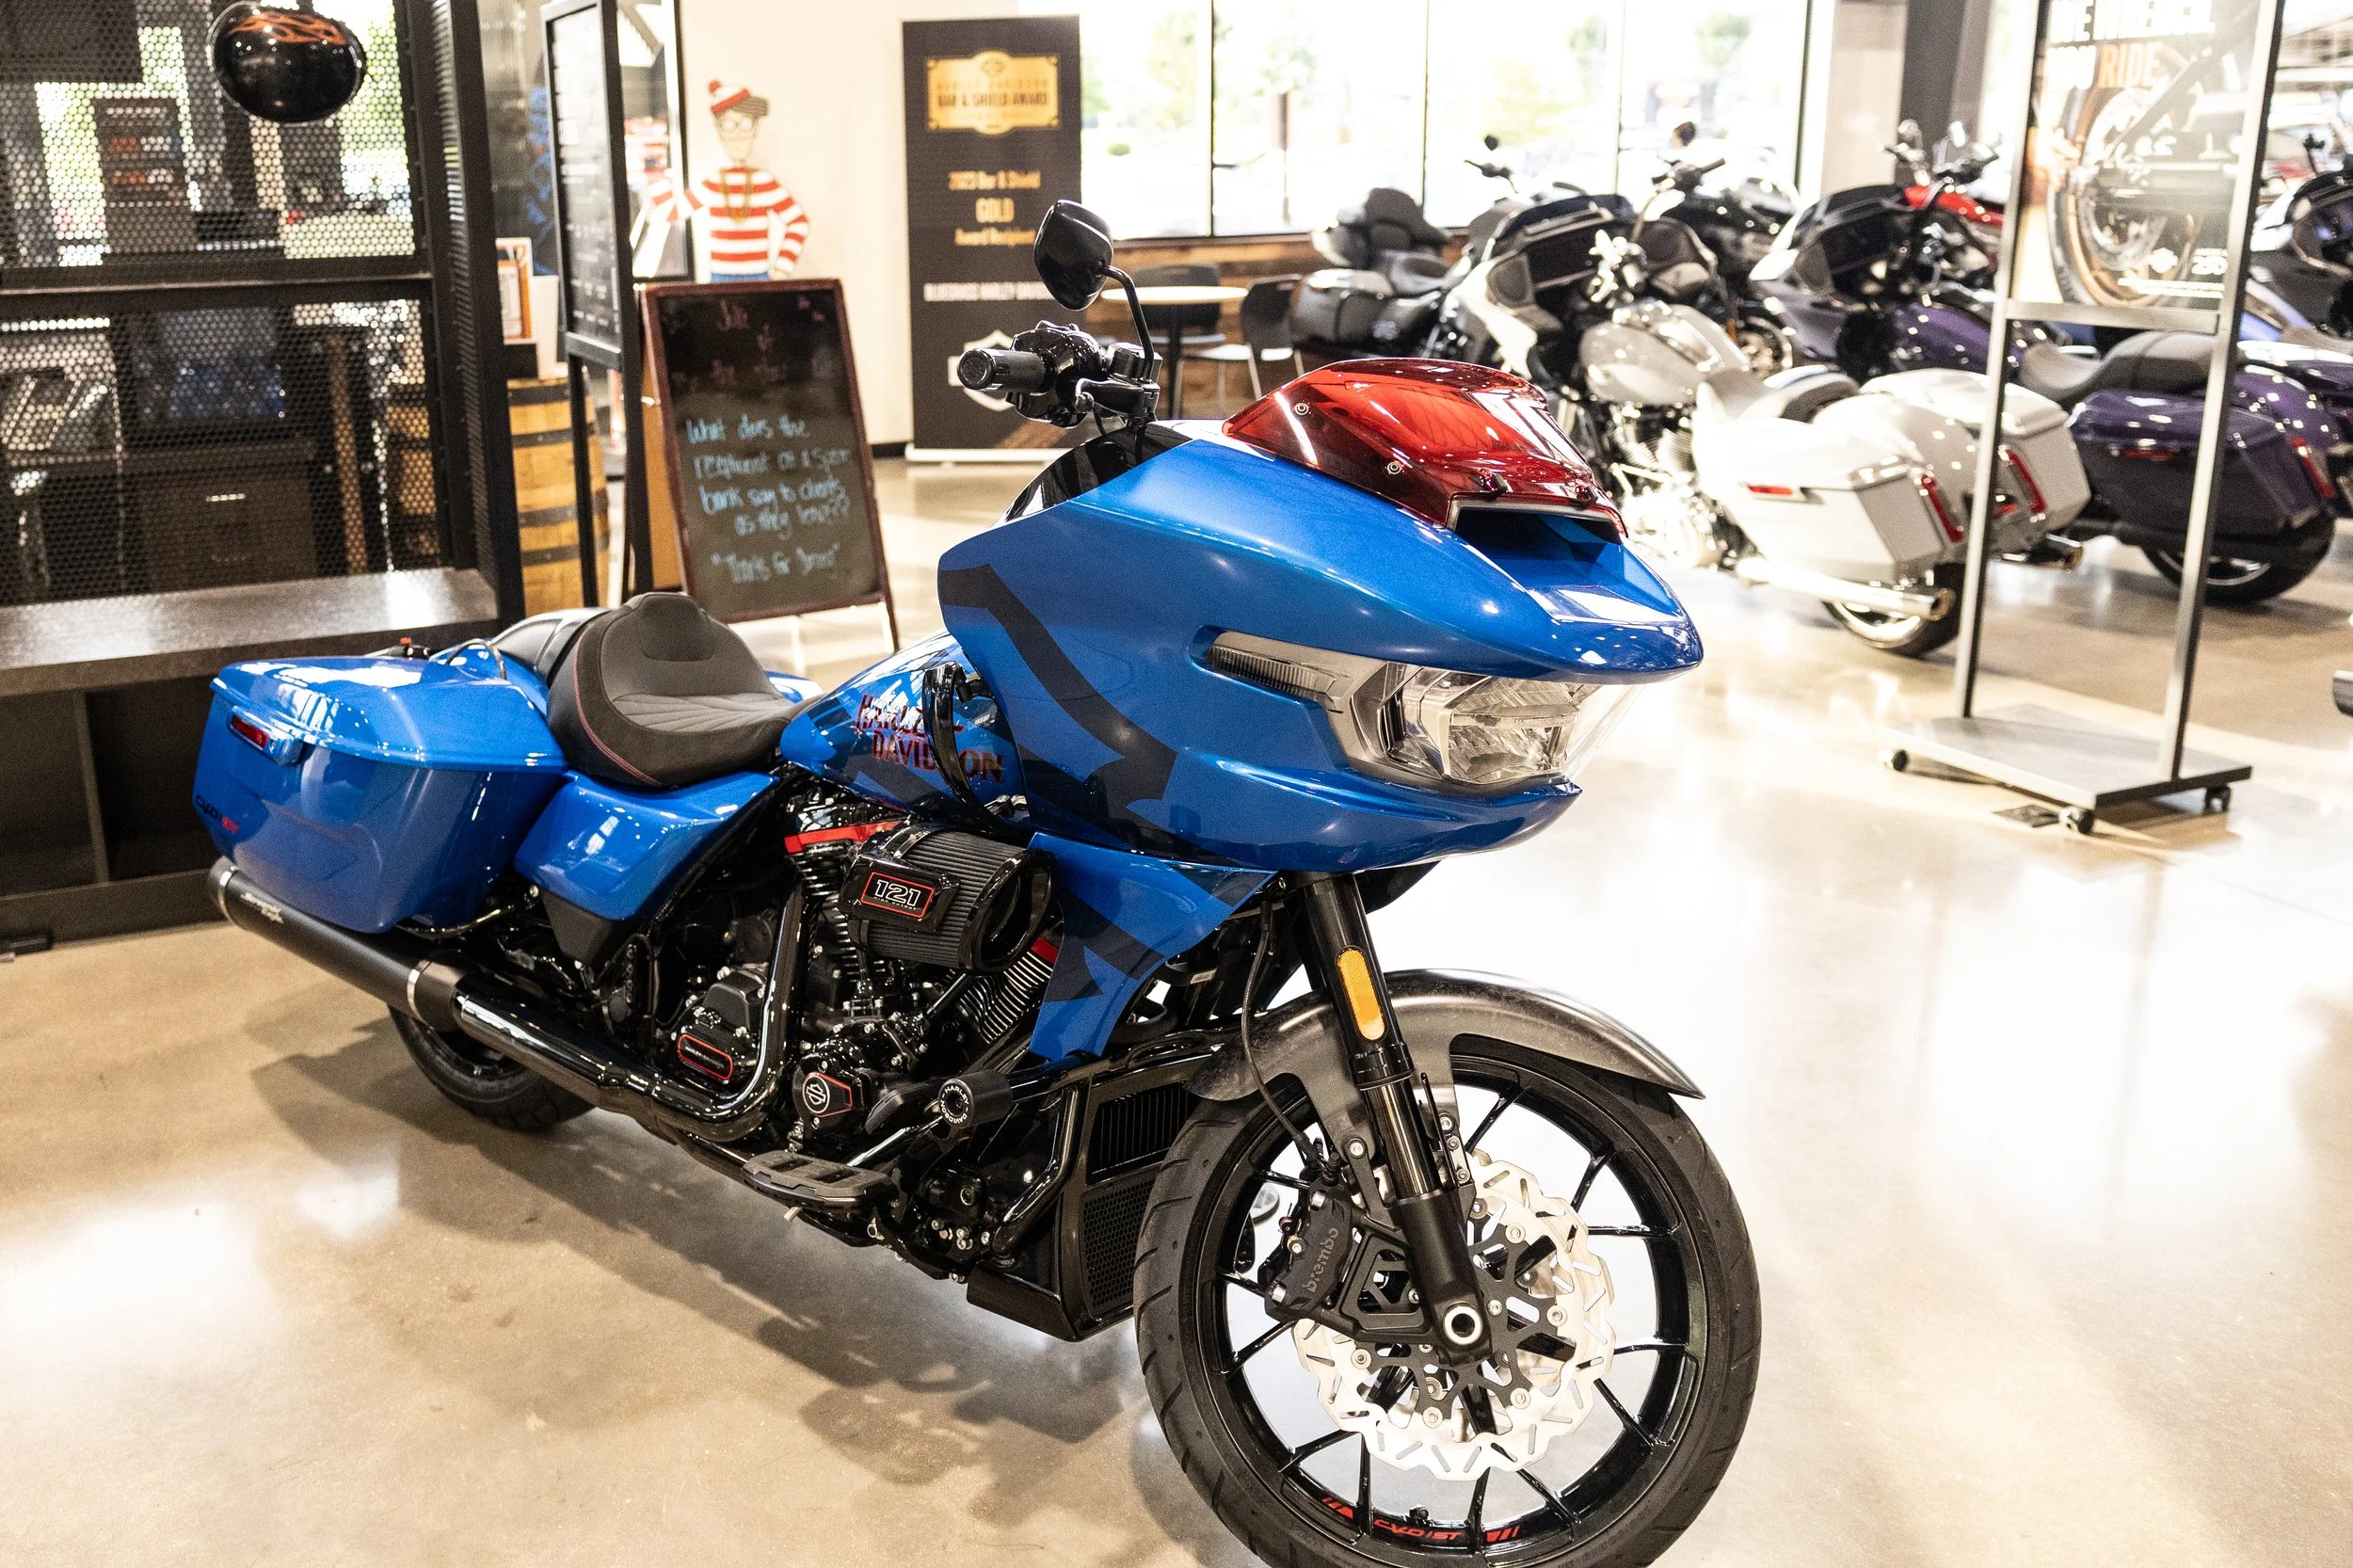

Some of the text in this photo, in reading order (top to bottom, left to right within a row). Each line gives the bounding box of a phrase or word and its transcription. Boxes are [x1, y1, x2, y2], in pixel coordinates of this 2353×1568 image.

[2097, 40, 2166, 88] RIDE
[972, 93, 1008, 106] SHIELD
[1013, 92, 1048, 105] AWARD
[975, 197, 1016, 224] GOLD
[685, 417, 727, 444] What
[737, 412, 775, 440] does
[872, 728, 1005, 785] DAVIDON
[874, 879, 921, 906] 121
[1302, 1227, 1339, 1293] brembo
